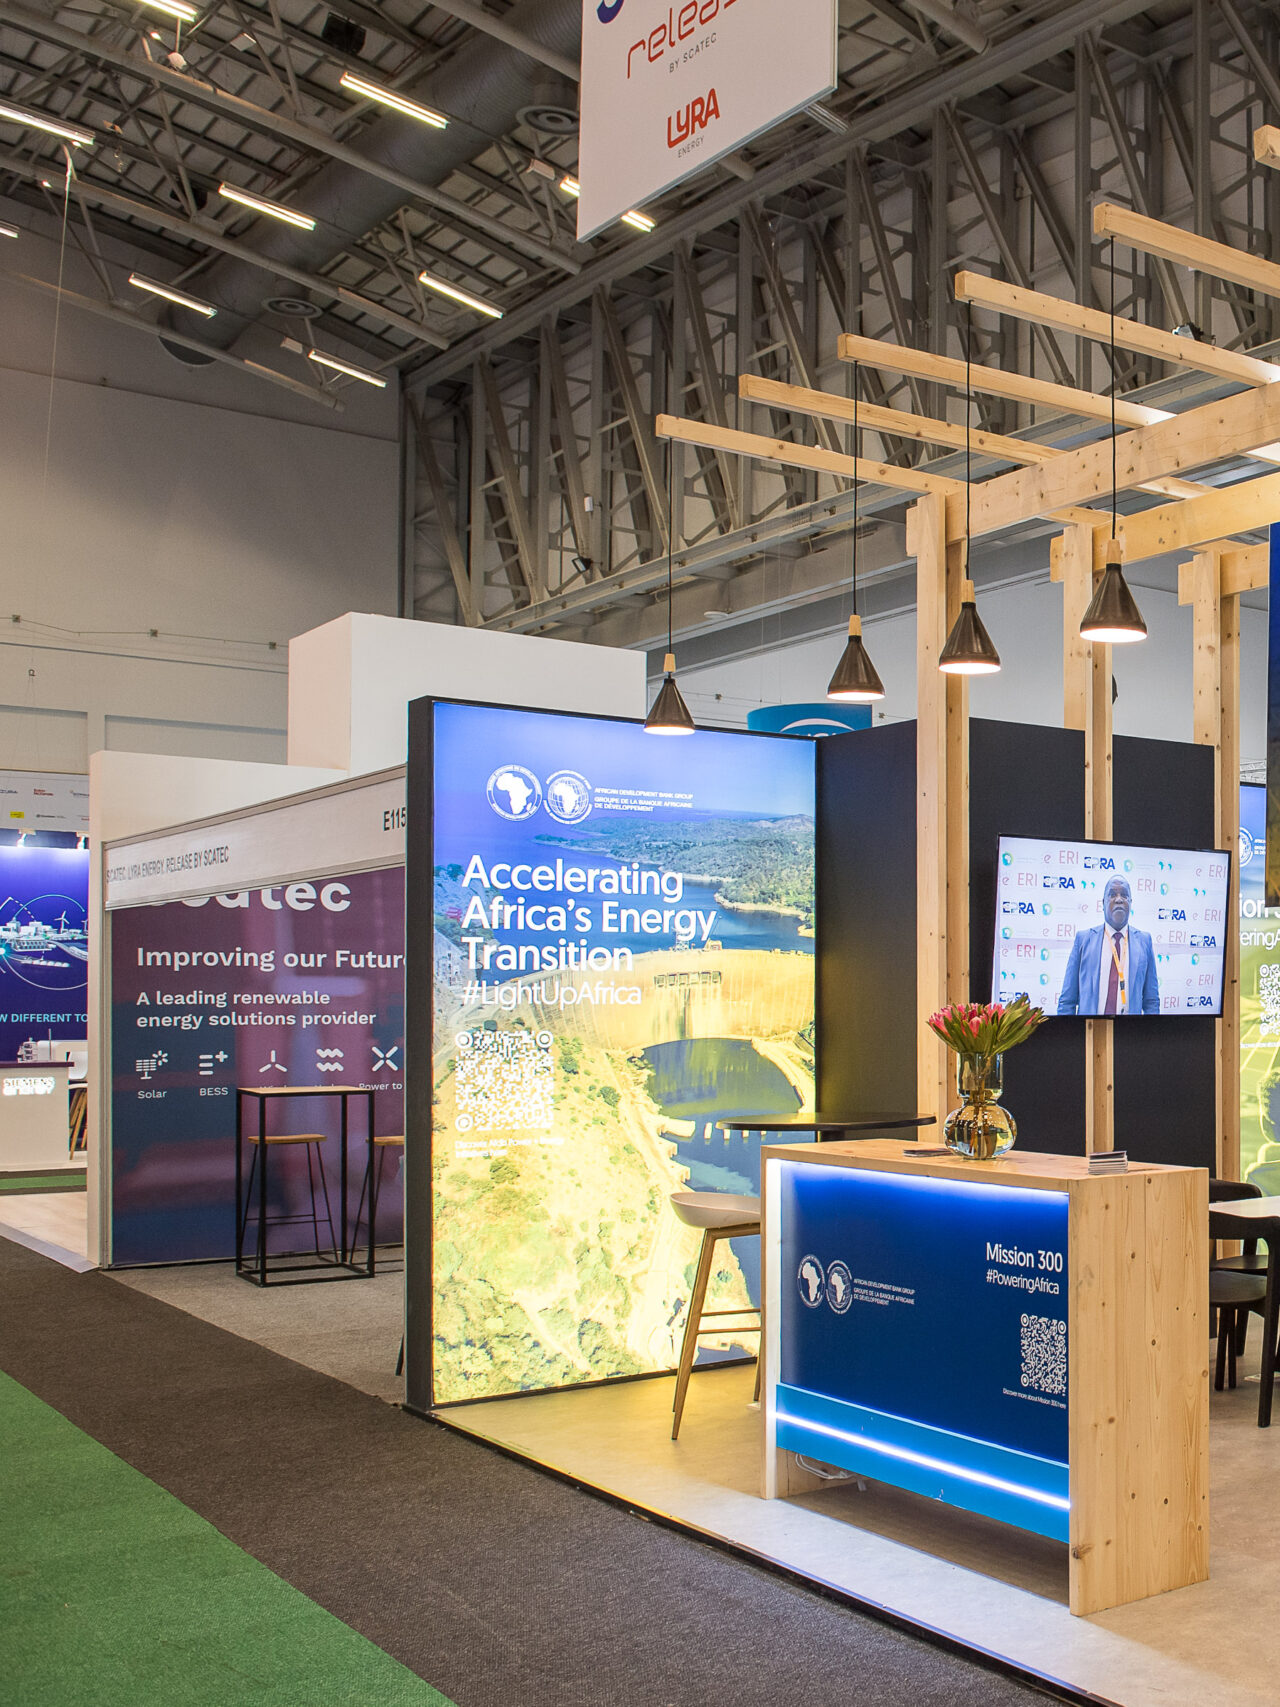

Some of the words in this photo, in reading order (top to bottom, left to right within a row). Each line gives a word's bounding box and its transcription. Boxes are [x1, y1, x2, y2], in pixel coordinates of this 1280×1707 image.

[669, 60, 679, 73] BY
[683, 32, 717, 63] SCATEC
[667, 88, 720, 148] LYRA
[678, 136, 704, 158] ENERGY
[594, 787, 619, 795] AFRICAN
[619, 789, 658, 797] DEVELOPMENT
[128, 864, 141, 880] LYRA
[166, 853, 193, 873] RELEASE
[194, 852, 203, 868] BY
[203, 845, 229, 866] SCATEC
[1059, 850, 1079, 864] ERI
[461, 854, 684, 903] Accelerating
[1209, 865, 1226, 878] ERI
[1018, 873, 1038, 886] ERI
[1137, 878, 1156, 892] ERI
[602, 901, 717, 941] Energy
[1204, 909, 1222, 922] ERI
[1057, 924, 1076, 937] ERI
[1169, 930, 1187, 943] ERI
[461, 936, 633, 972] Transition
[1016, 944, 1036, 958] ERI
[137, 947, 275, 972] Improving
[283, 952, 327, 968] our
[336, 950, 406, 969] Futur
[1198, 974, 1215, 986] ERI
[136, 992, 150, 1005] A
[156, 990, 227, 1008] leading
[233, 990, 330, 1005] renewable
[462, 980, 642, 1010] #LightUpAfrica
[1163, 996, 1180, 1008] ERI
[11, 1013, 72, 1023] DIFFERENT
[136, 1014, 203, 1030] energy
[209, 1011, 296, 1026] solutions
[302, 1011, 376, 1028] provider
[200, 1087, 229, 1096] BESS
[391, 1082, 403, 1091] to
[138, 1090, 167, 1099] Solar
[986, 1242, 1035, 1268] Mission
[1037, 1249, 1063, 1273] 300
[867, 1280, 892, 1290] DEVELOPMENT
[902, 1287, 915, 1295] GROUP
[986, 1268, 1059, 1295] #PoweringAfrica
[853, 1287, 868, 1295] GROUPE
[879, 1291, 895, 1300] BANQUE
[895, 1295, 915, 1305] AFRICAINE
